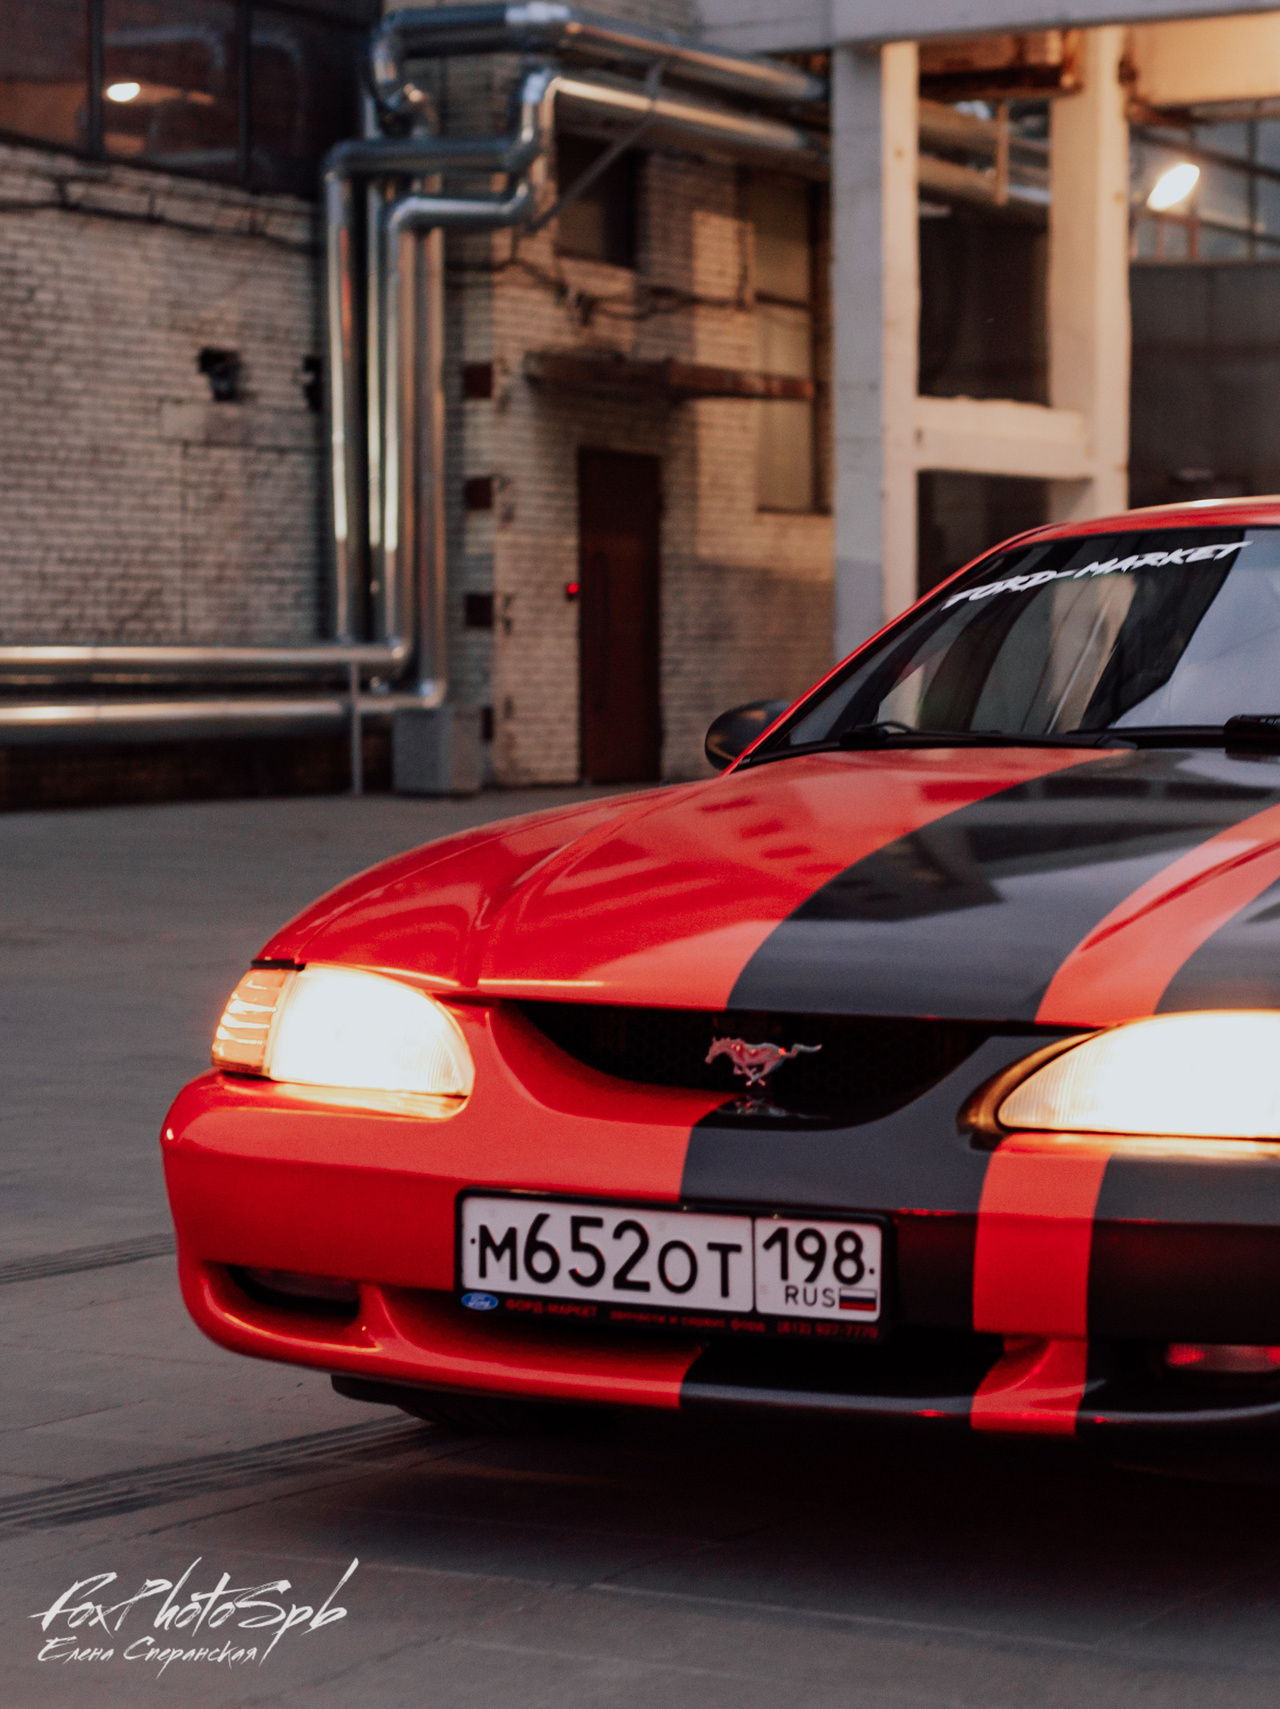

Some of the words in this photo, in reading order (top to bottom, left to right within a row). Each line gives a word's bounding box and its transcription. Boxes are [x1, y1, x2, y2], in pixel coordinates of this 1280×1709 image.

[940, 540, 1255, 611] FORD-MARKET
[762, 1227, 866, 1286] 198
[784, 1285, 836, 1308] RUS
